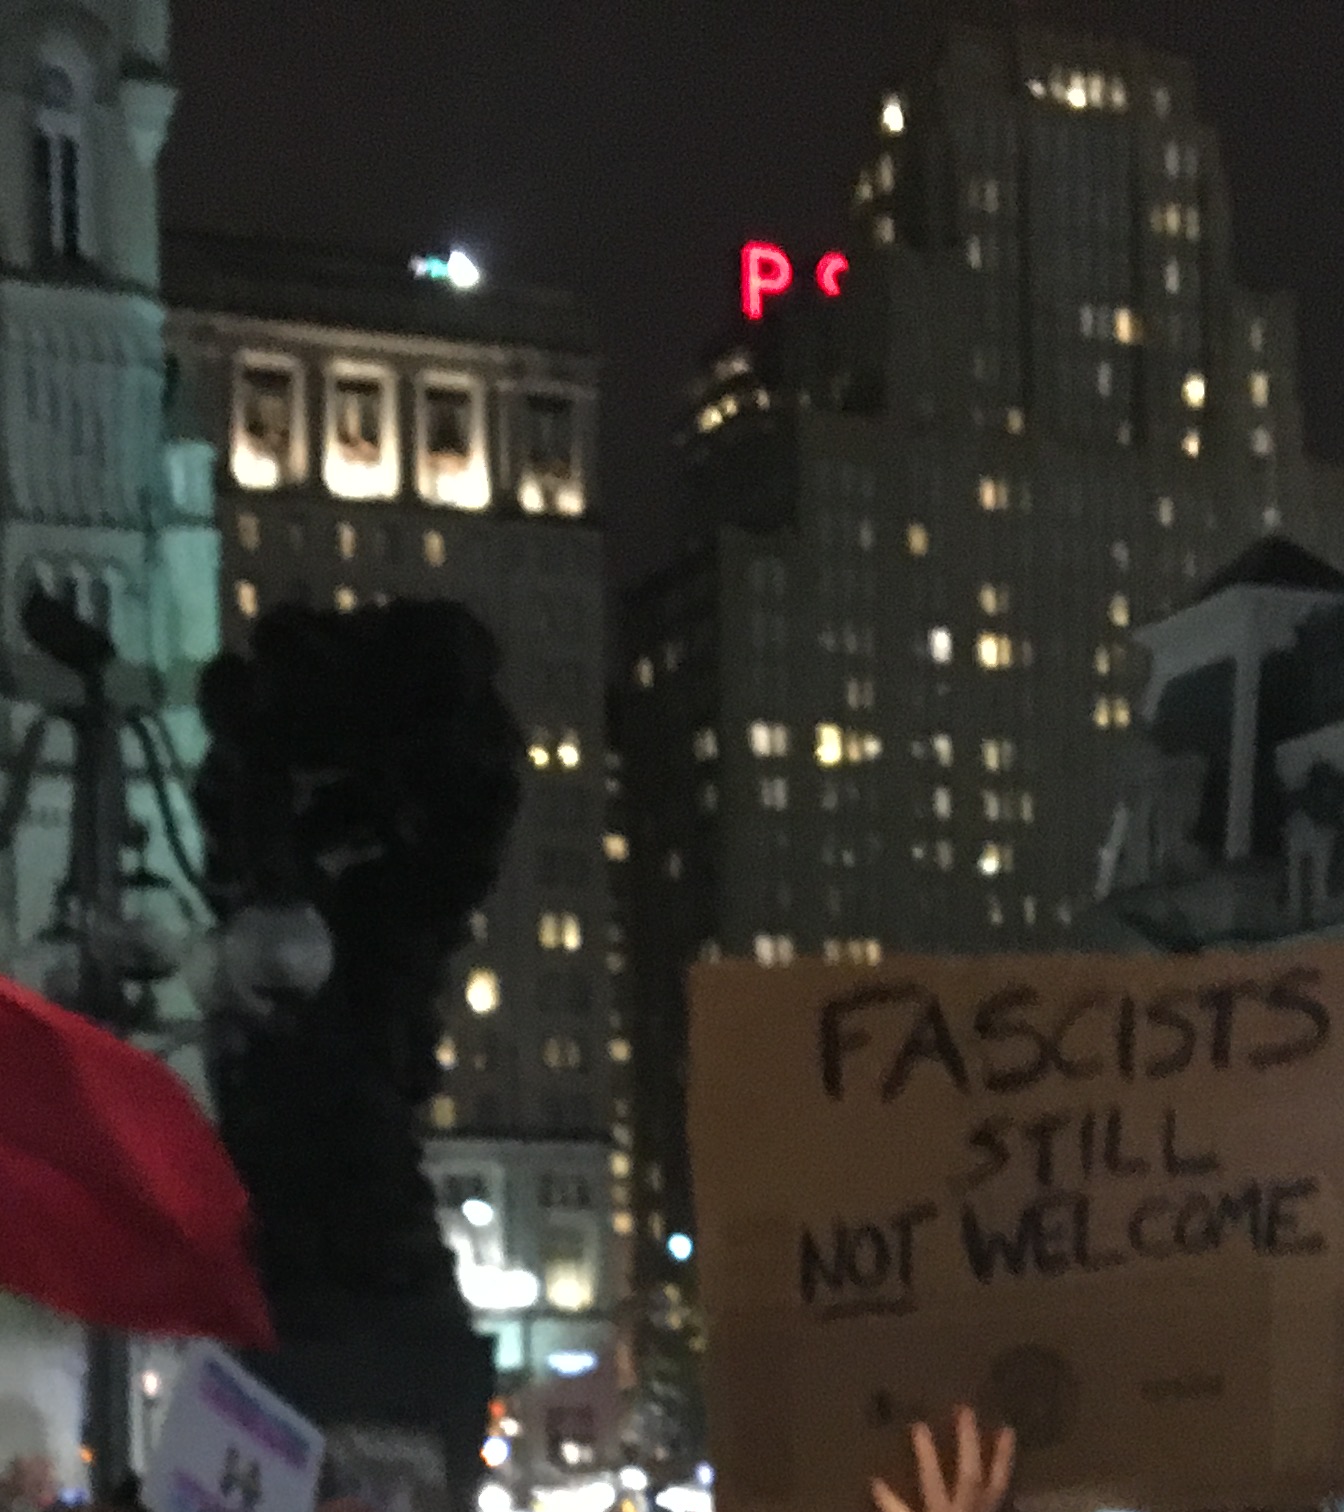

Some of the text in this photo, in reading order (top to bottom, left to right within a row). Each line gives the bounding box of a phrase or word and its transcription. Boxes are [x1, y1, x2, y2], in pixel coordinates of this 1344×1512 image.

[817, 967, 1331, 1103] FASCISTS
[956, 1108, 1222, 1190] STILL
[799, 1175, 1327, 1303] NOT WELCOME
